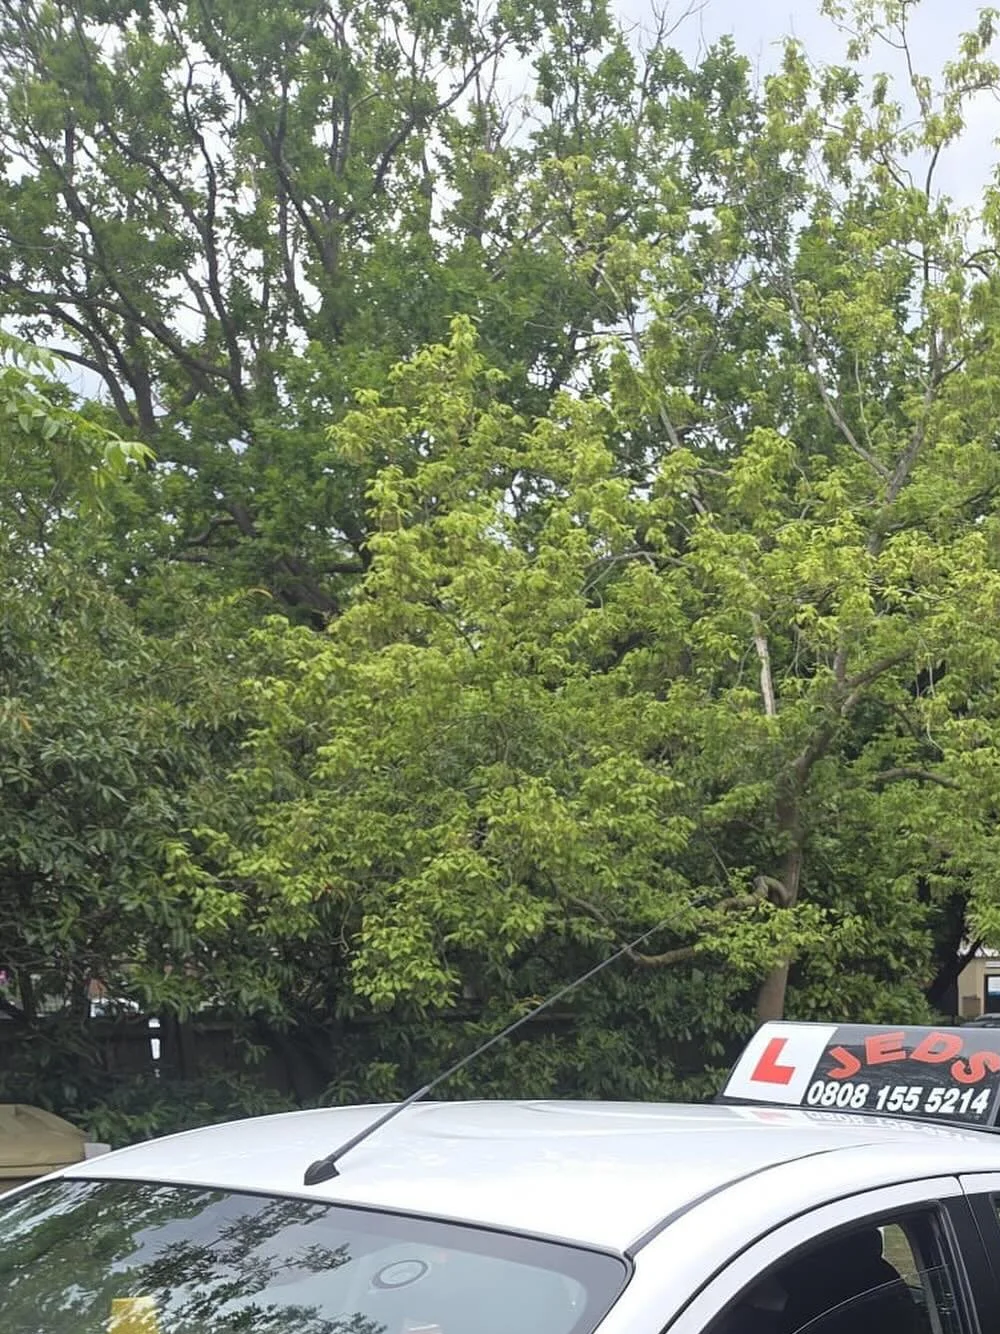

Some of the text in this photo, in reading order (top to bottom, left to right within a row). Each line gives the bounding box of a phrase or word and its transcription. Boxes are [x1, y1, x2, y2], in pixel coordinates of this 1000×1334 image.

[750, 1037, 796, 1085] L
[807, 1080, 989, 1114] 0808 155 5214
